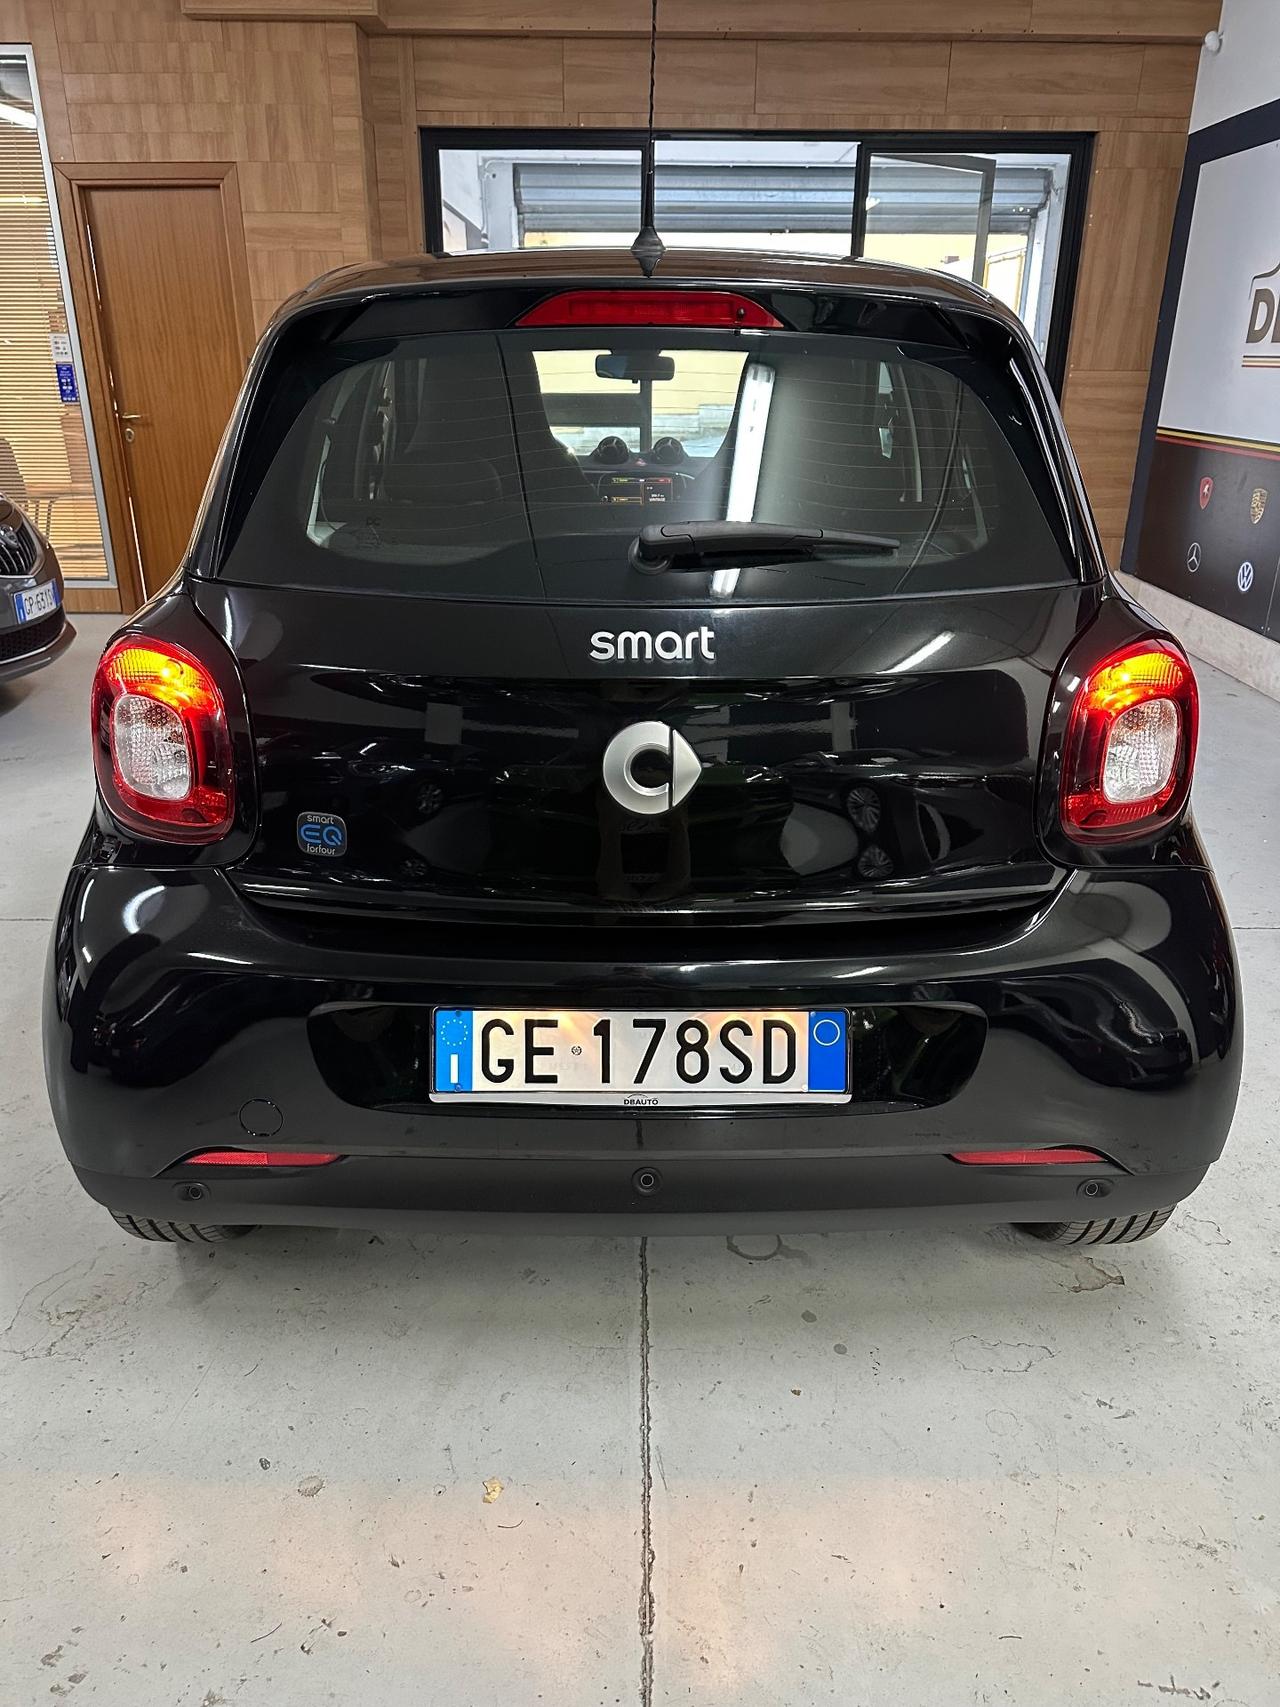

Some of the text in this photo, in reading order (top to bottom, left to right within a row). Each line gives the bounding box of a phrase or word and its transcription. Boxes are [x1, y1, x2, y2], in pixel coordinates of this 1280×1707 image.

[590, 626, 715, 660] smart
[307, 815, 334, 824] smart
[301, 824, 342, 846] EQ
[307, 844, 335, 855] forfour
[481, 1018, 797, 1085] GE 178SD
[623, 1098, 659, 1106] DBAUTO
